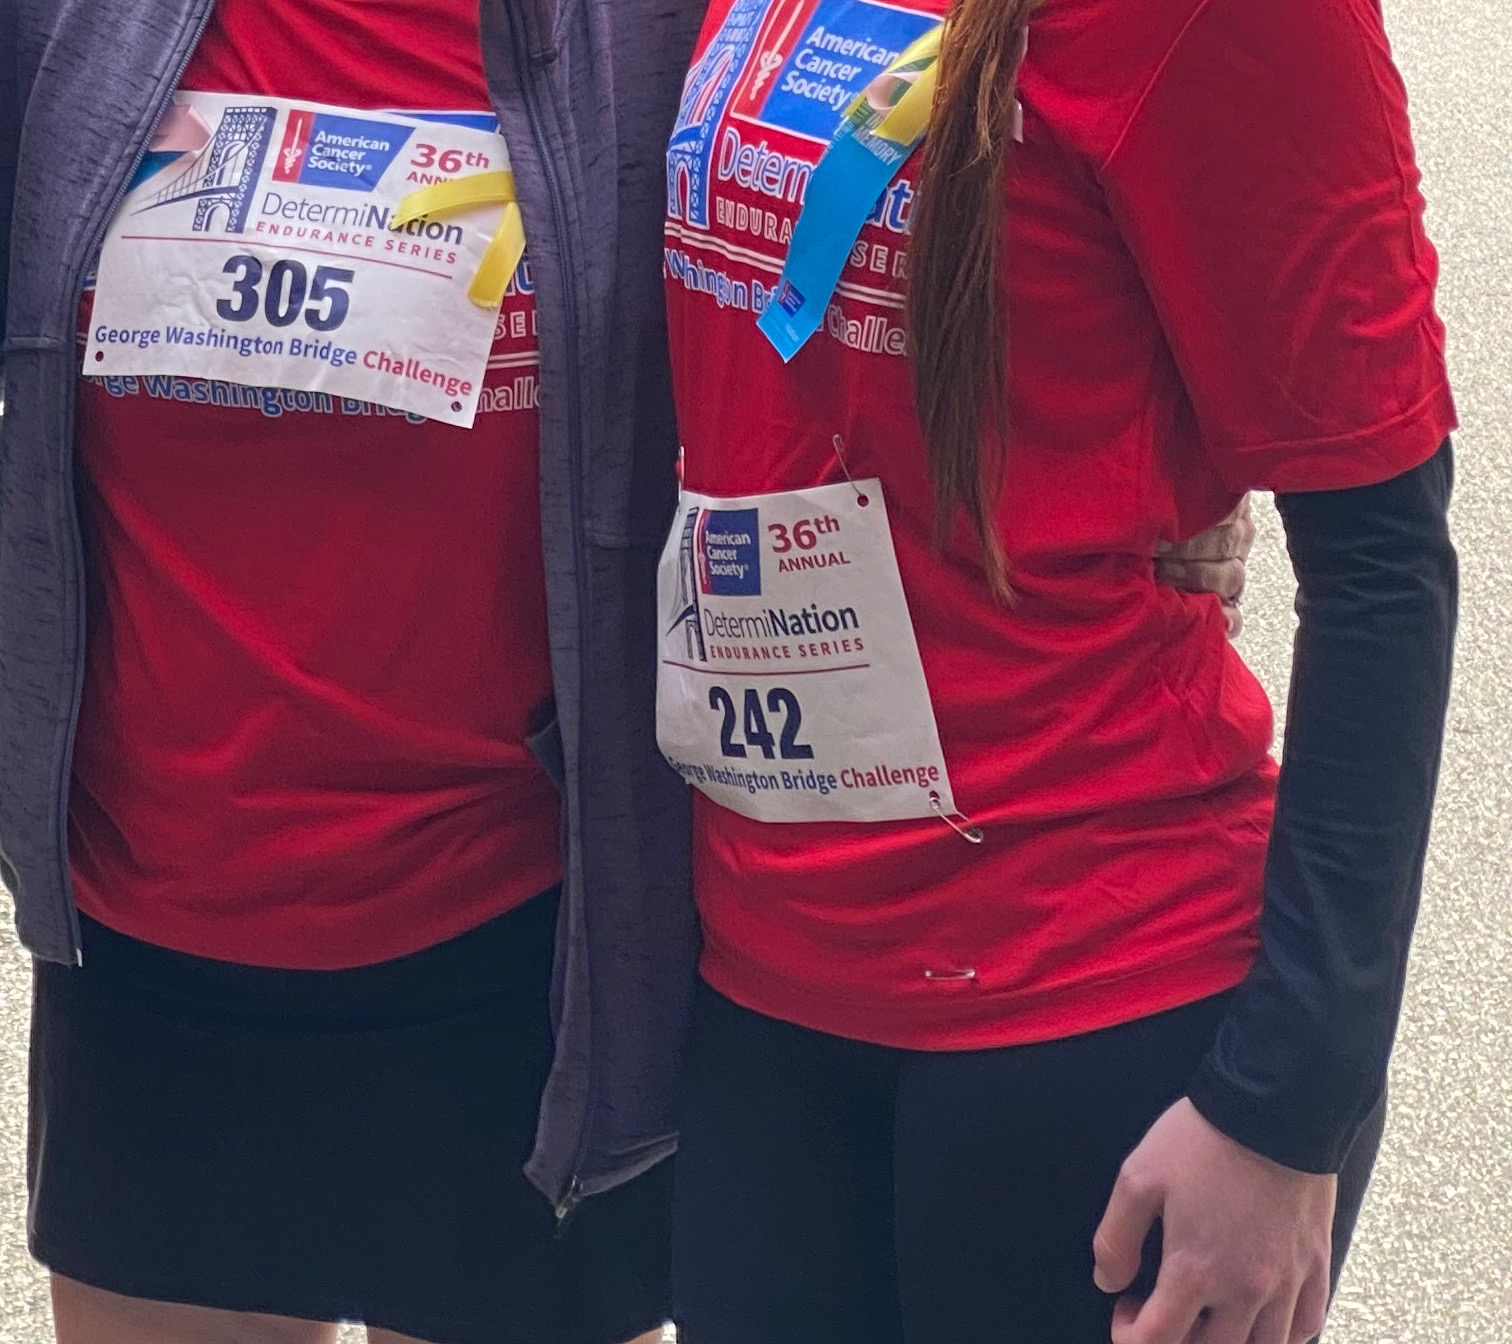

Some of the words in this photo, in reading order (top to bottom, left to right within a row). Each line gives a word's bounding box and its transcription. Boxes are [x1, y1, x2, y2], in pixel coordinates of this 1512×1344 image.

[806, 25, 900, 66] American
[794, 48, 863, 82] Cancer
[781, 70, 852, 112] Society
[311, 144, 366, 161] Cancer
[315, 130, 390, 152] American
[410, 142, 491, 174] 36th
[851, 124, 903, 167] MEMORY
[307, 156, 367, 177] Society
[255, 221, 375, 247] ENDURANCE
[385, 239, 458, 265] SERIES
[216, 254, 355, 333] 305
[95, 325, 161, 348] George
[165, 326, 284, 357] Washington
[289, 338, 358, 367] Bridge
[362, 350, 473, 397] Challenge
[705, 530, 752, 546] American
[767, 515, 841, 554] 36th
[706, 546, 738, 561] Cancer
[709, 561, 746, 580] Society
[778, 551, 852, 573] ANNUAL
[703, 603, 860, 639] DetermiNation
[709, 645, 791, 660] ENDURANCE
[798, 637, 865, 658] SERIES
[707, 685, 816, 761] 242
[702, 762, 780, 794] Washington
[780, 769, 838, 795] Bridge
[840, 763, 940, 789] Challenge
